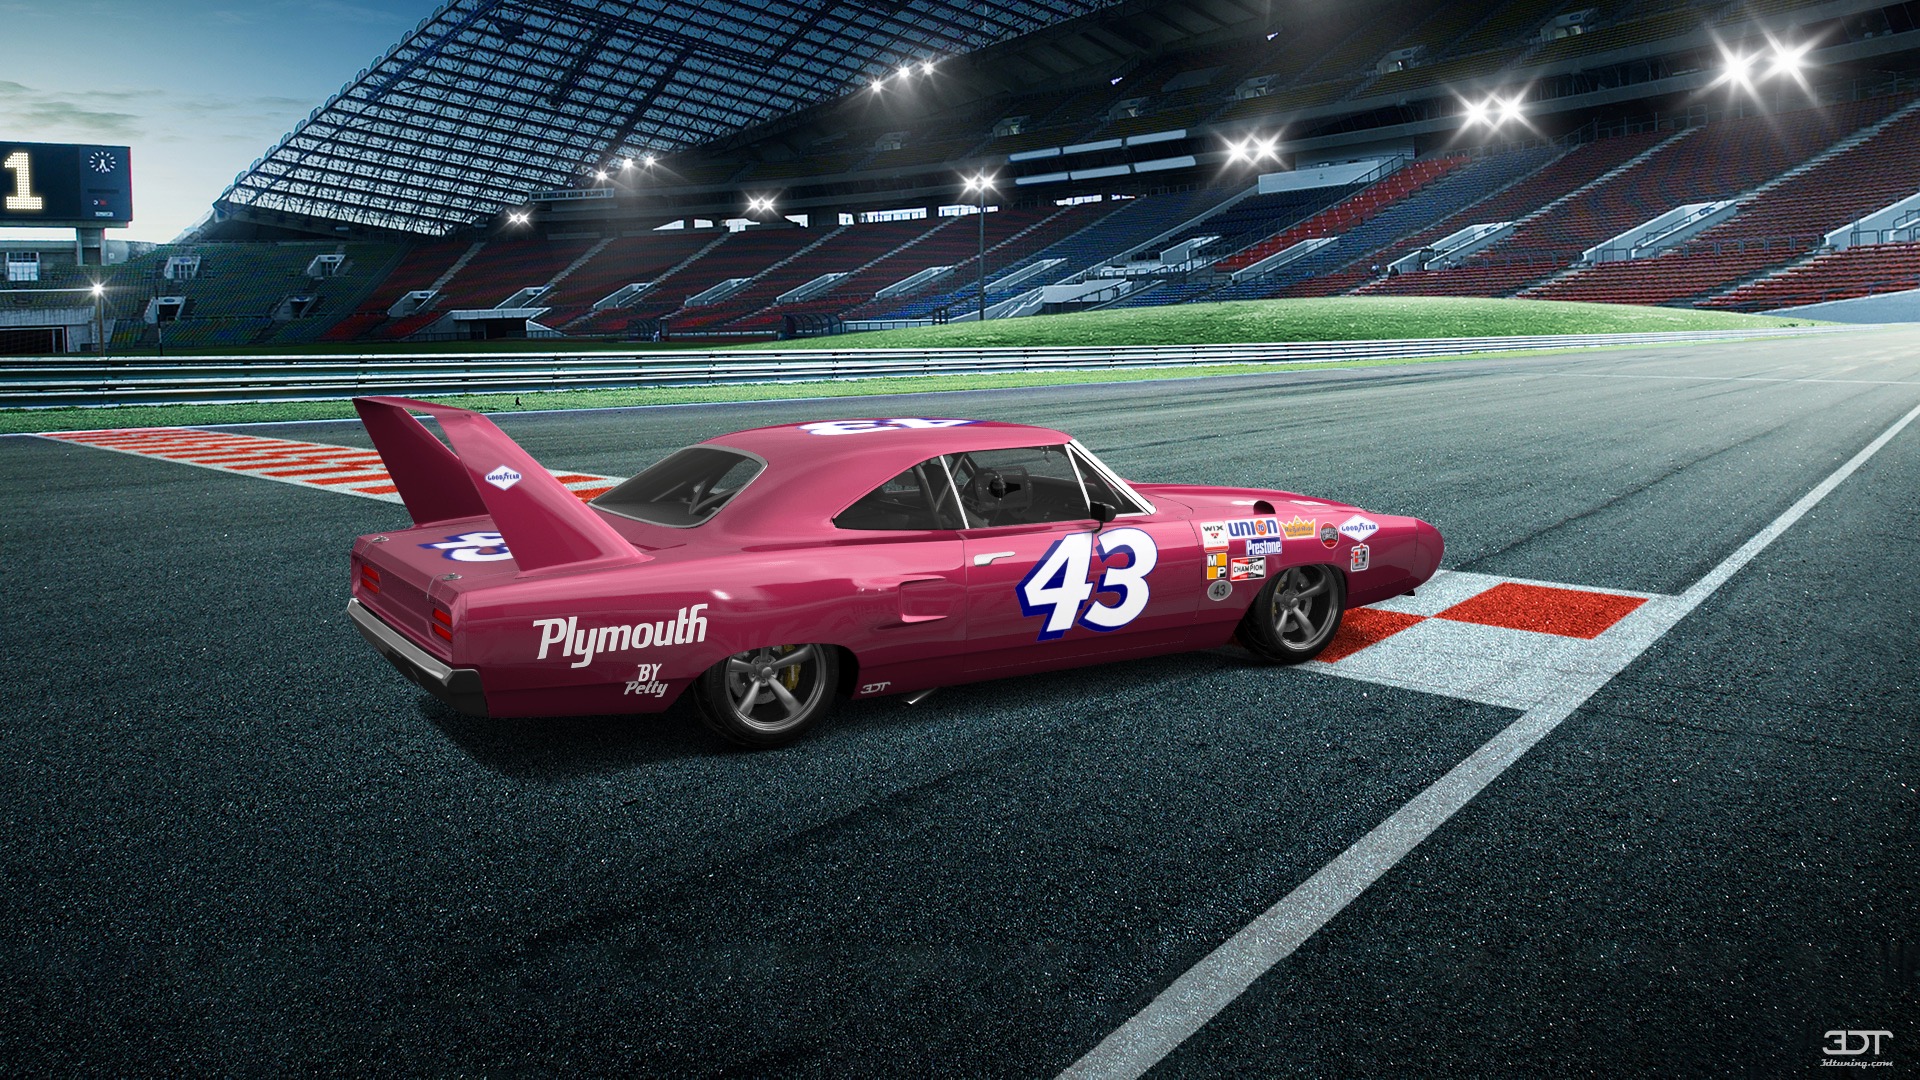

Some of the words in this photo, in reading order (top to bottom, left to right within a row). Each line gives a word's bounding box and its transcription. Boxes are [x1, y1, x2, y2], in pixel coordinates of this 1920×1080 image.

[4, 152, 43, 210] 1
[1341, 523, 1377, 533] GOODYEAR
[1247, 540, 1281, 556] Prestone
[1233, 563, 1263, 573] CHAMPION
[1015, 527, 1158, 642] 43
[1214, 585, 1226, 597] 43
[533, 603, 708, 669] Plymouth
[637, 663, 662, 682] BY
[624, 681, 668, 698] Petty
